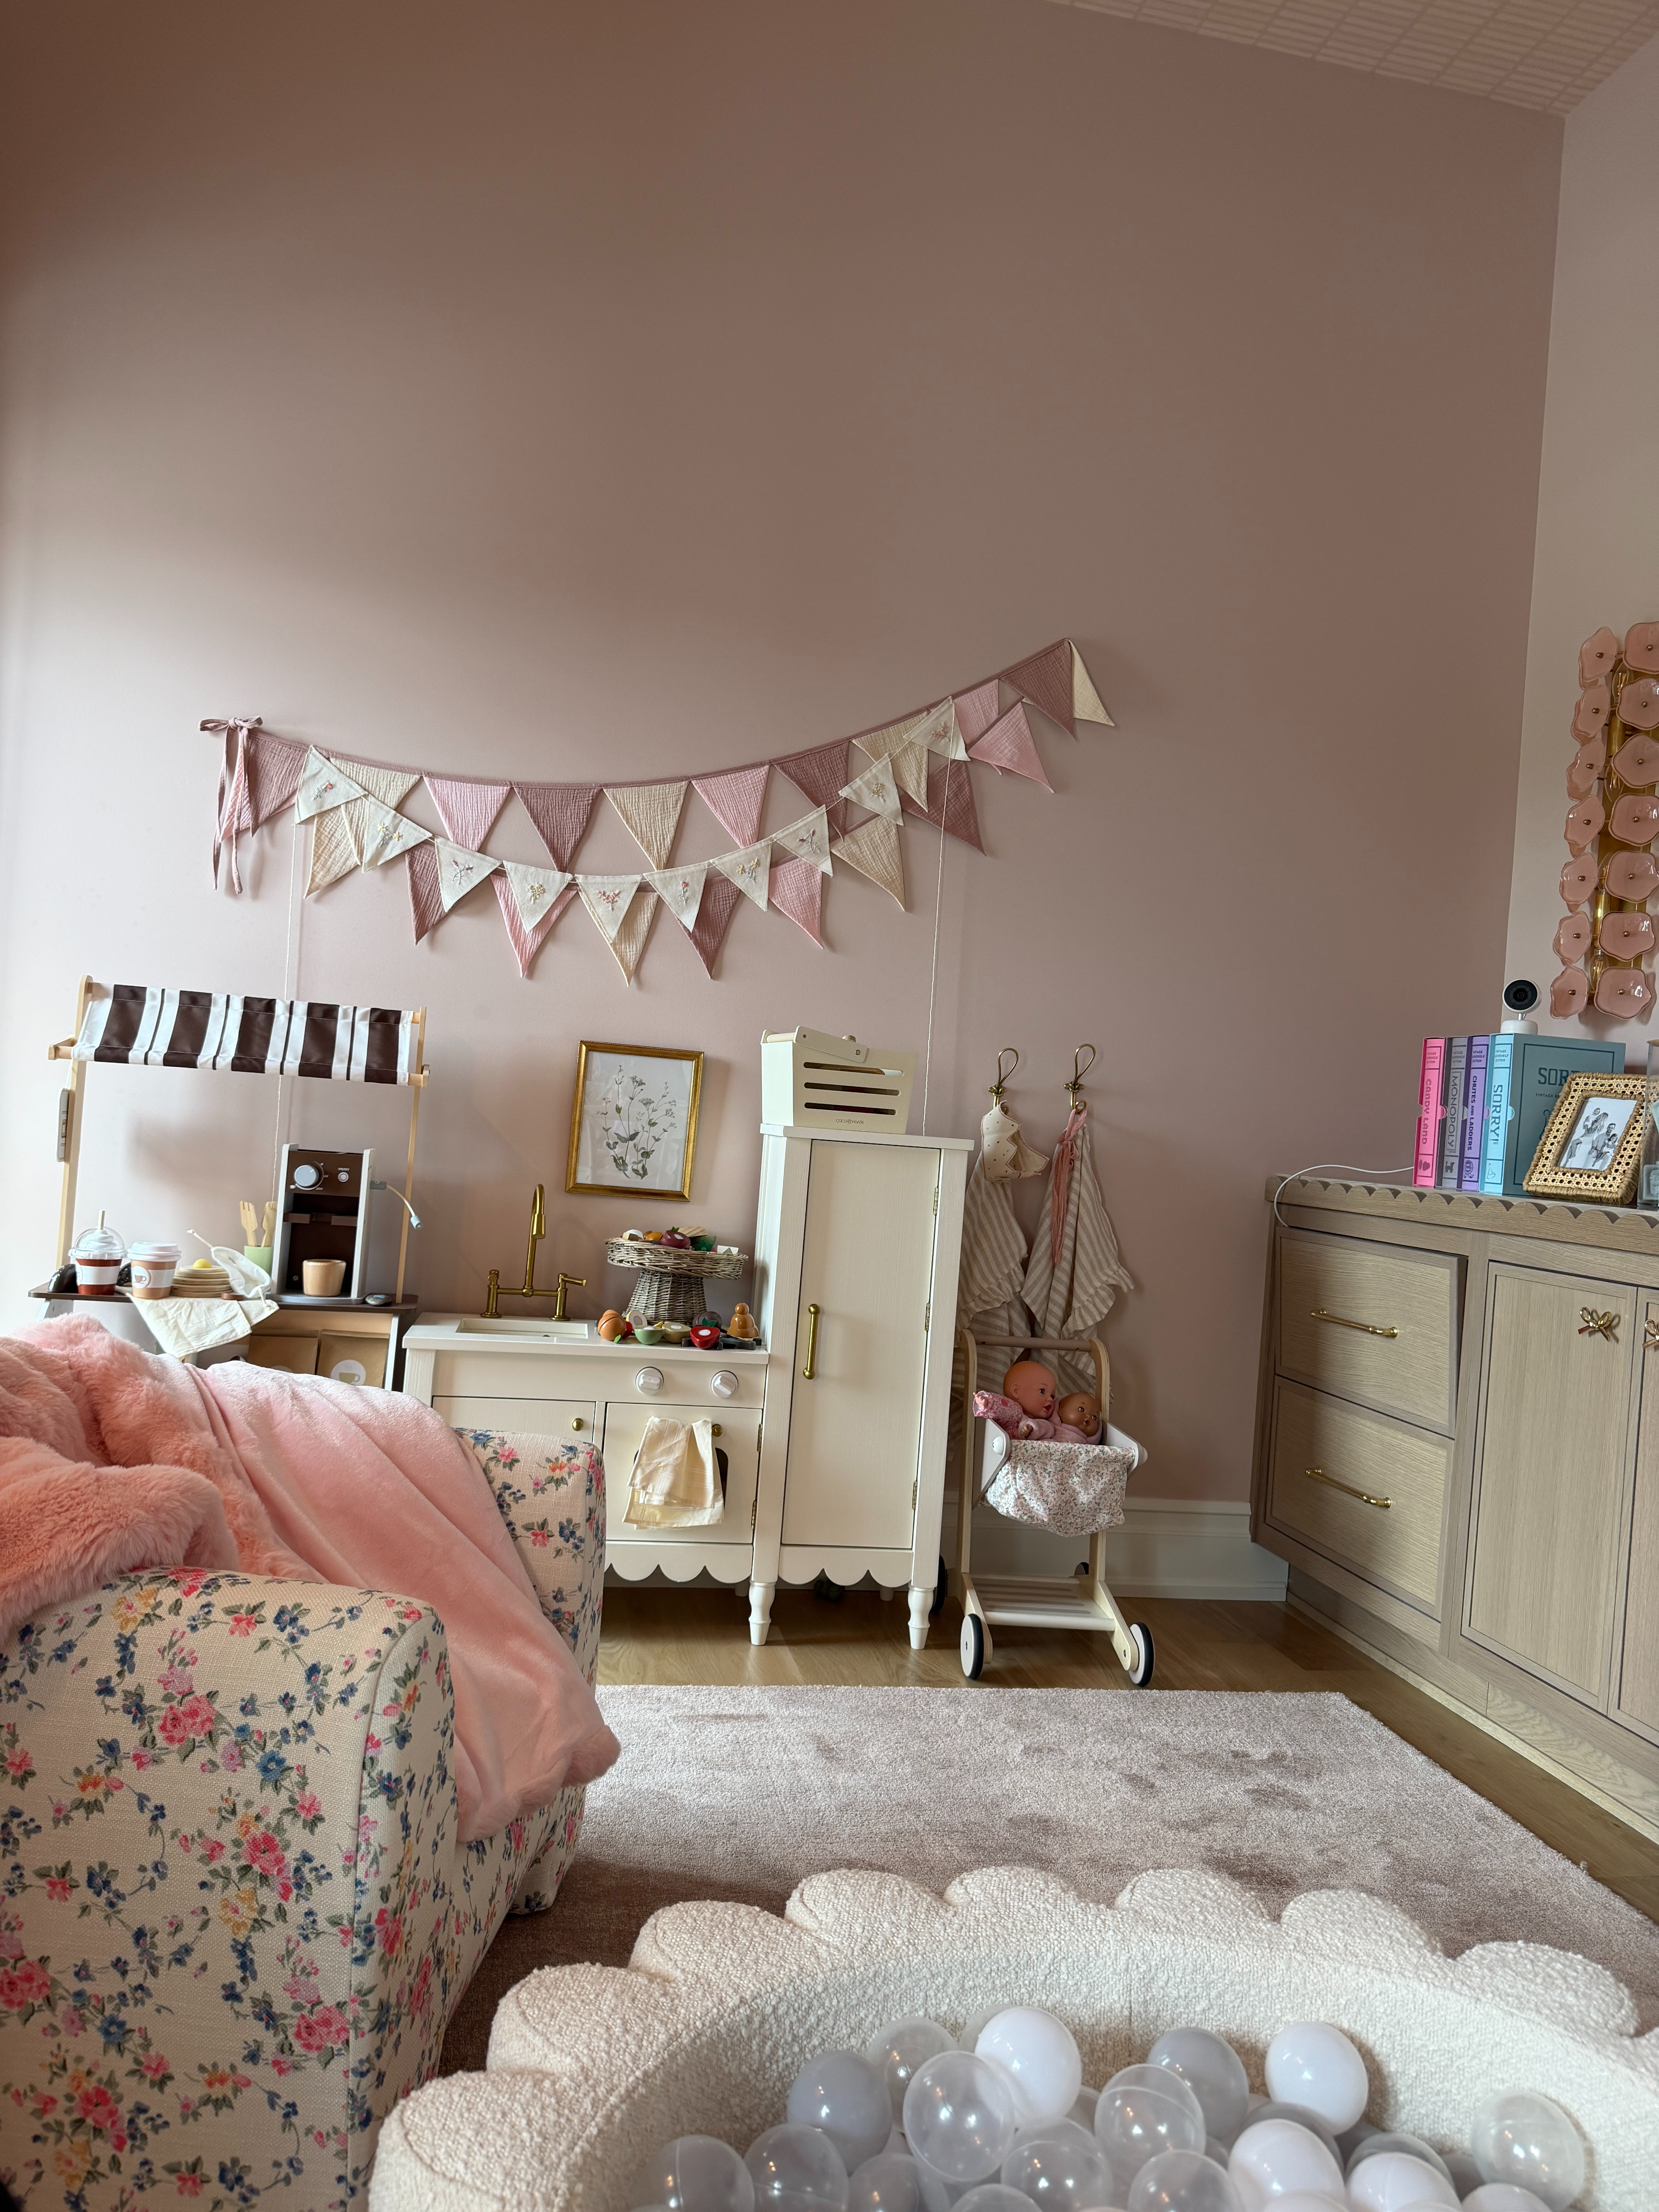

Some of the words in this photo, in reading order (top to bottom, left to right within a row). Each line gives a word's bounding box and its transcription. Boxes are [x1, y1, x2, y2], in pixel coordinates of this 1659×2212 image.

[1538, 1067, 1580, 1086] SOR
[1448, 1076, 1458, 1147] MONOPOLY
[1489, 1084, 1503, 1142] SORRY!
